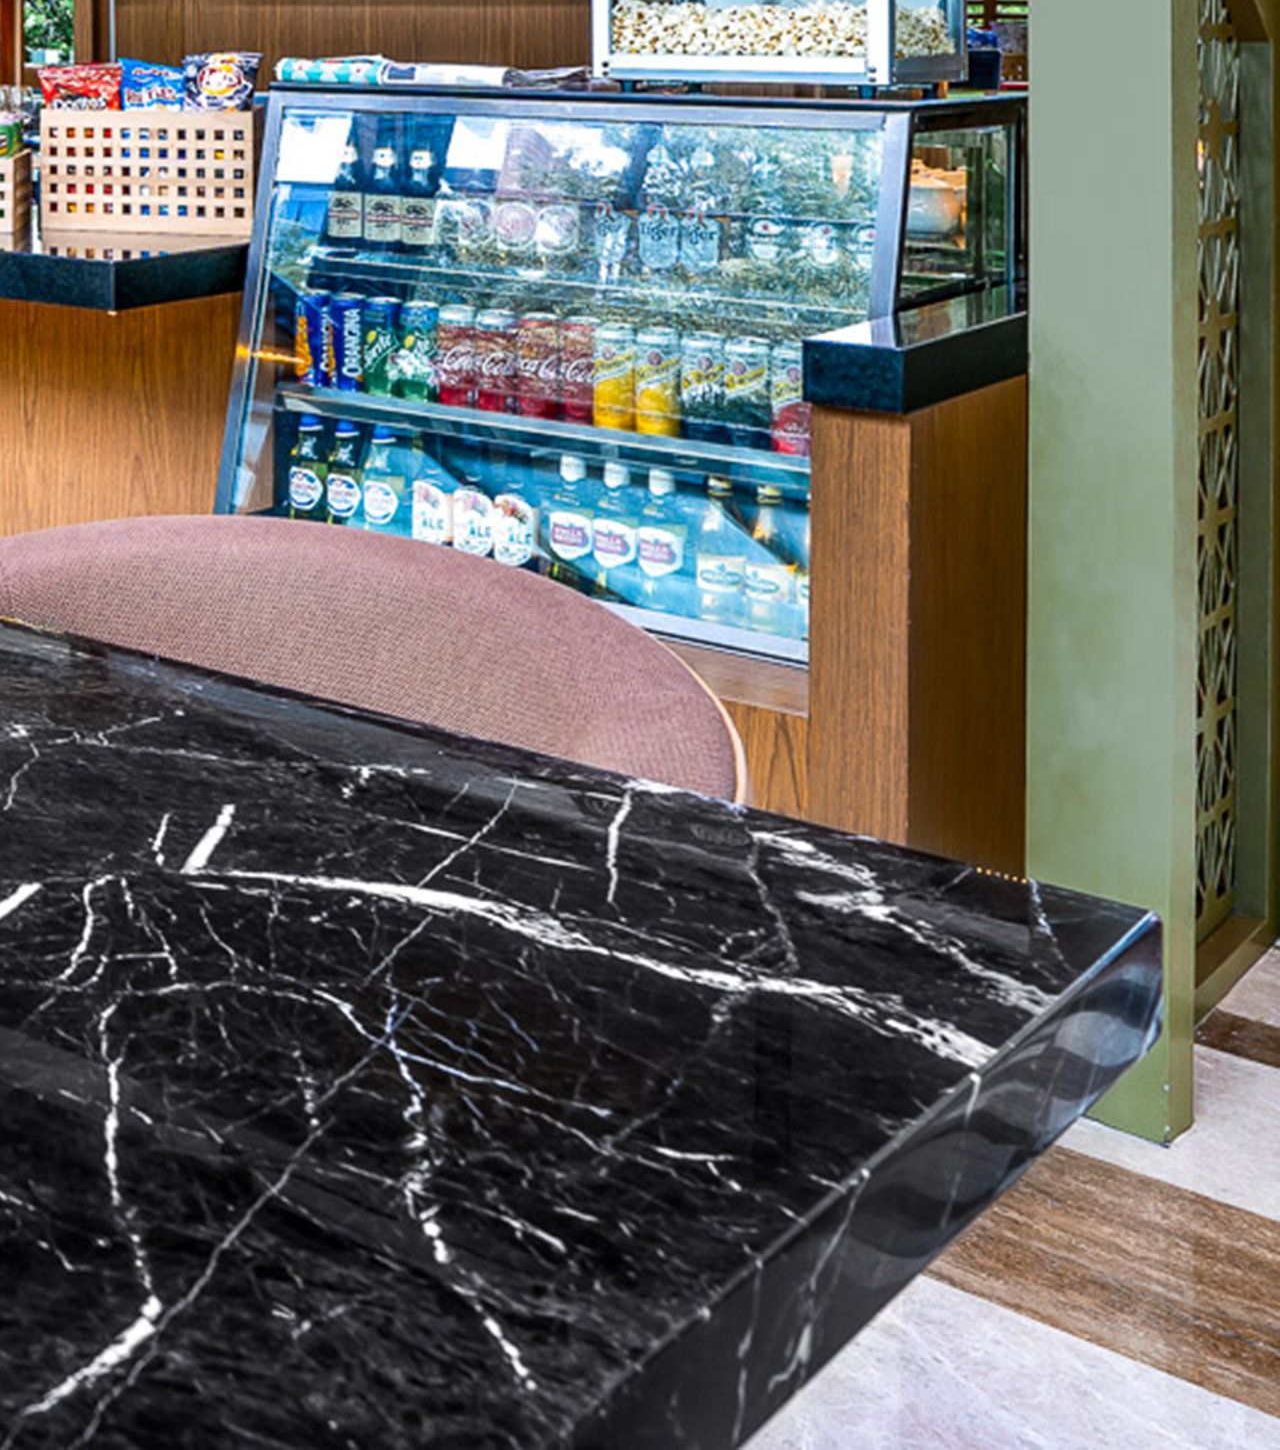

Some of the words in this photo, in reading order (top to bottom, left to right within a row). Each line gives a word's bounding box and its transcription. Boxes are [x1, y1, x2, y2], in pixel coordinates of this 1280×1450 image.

[422, 518, 443, 530] ALE
[470, 526, 491, 538] ALE
[509, 533, 532, 546] ALE
